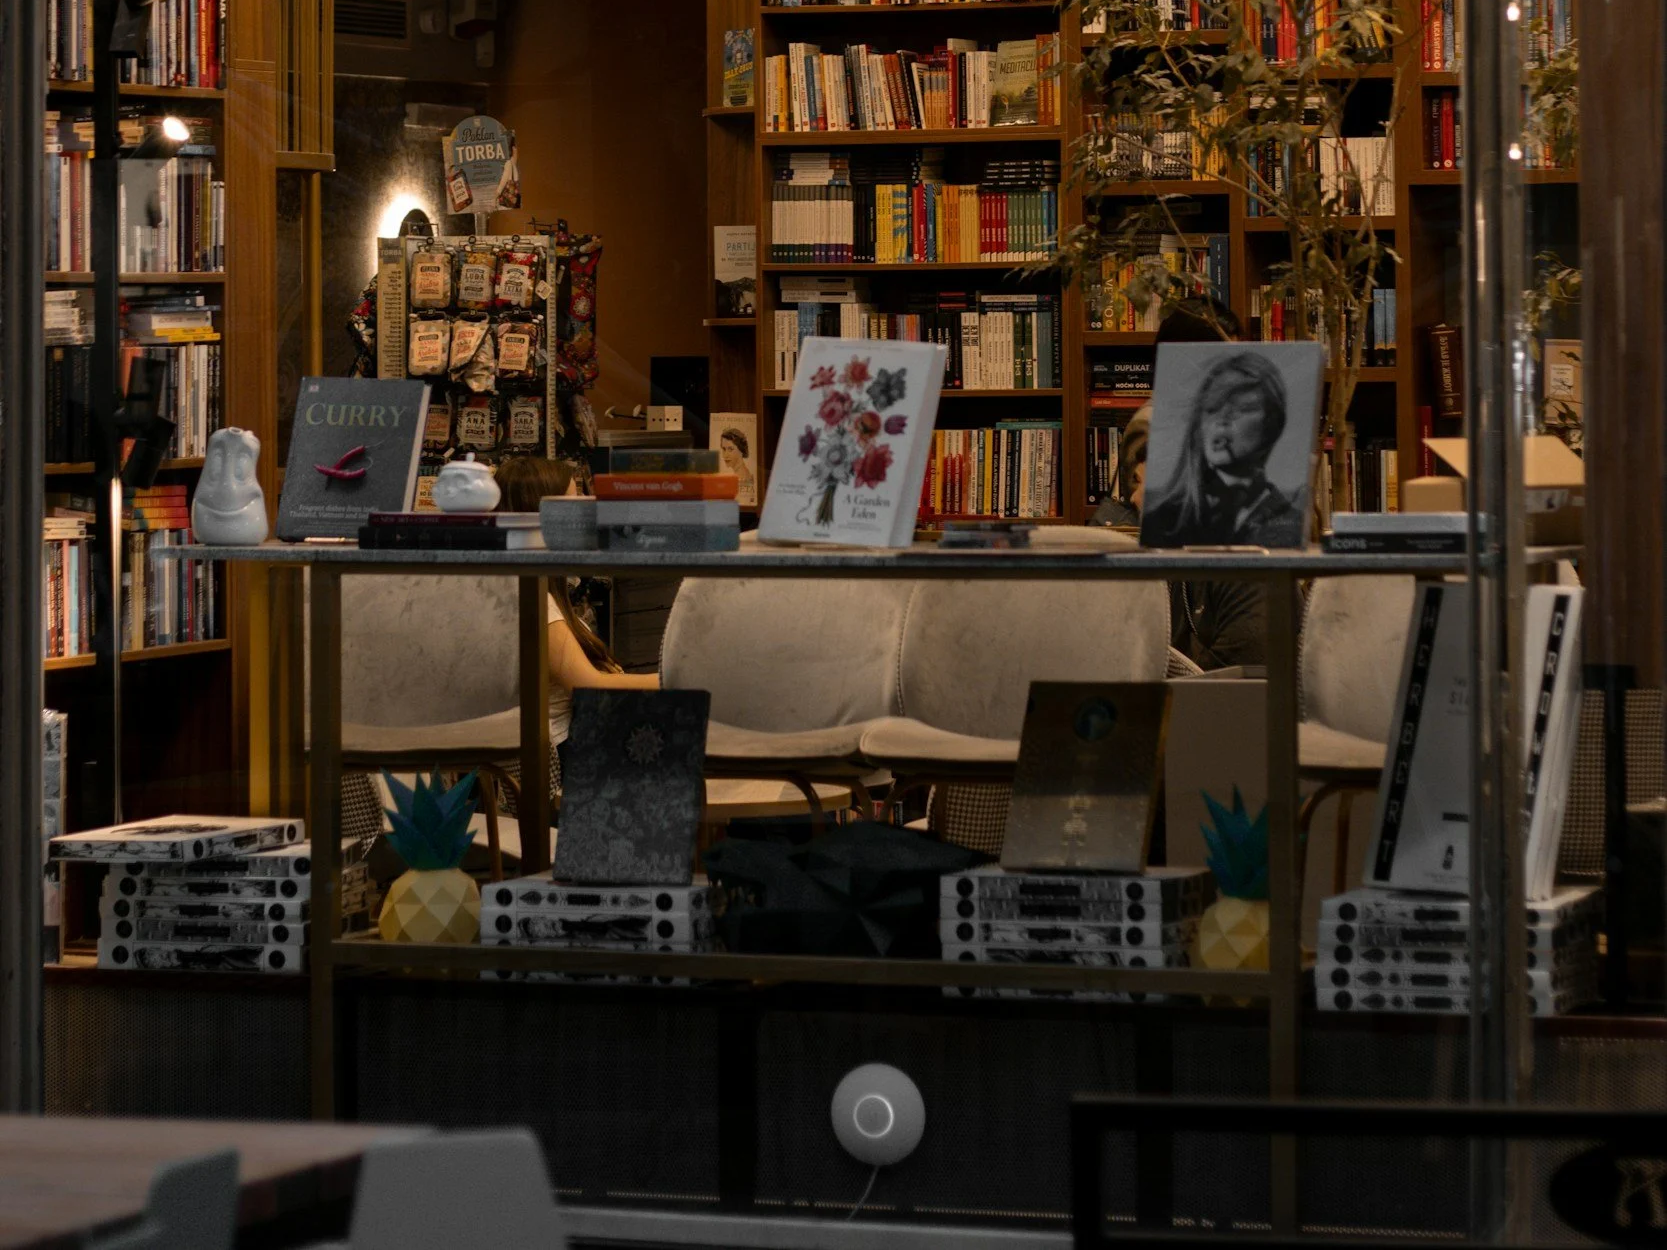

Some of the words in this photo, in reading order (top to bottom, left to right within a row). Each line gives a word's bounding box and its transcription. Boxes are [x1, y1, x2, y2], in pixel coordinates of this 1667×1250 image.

[461, 128, 496, 143] Poklon
[455, 142, 506, 163] TORBA
[305, 402, 406, 427] CURRY
[613, 481, 645, 491] Vincent
[645, 482, 661, 491] van
[661, 481, 684, 493] Gogh
[844, 495, 852, 504] A
[853, 494, 891, 508] Garden
[851, 508, 877, 520] Eden
